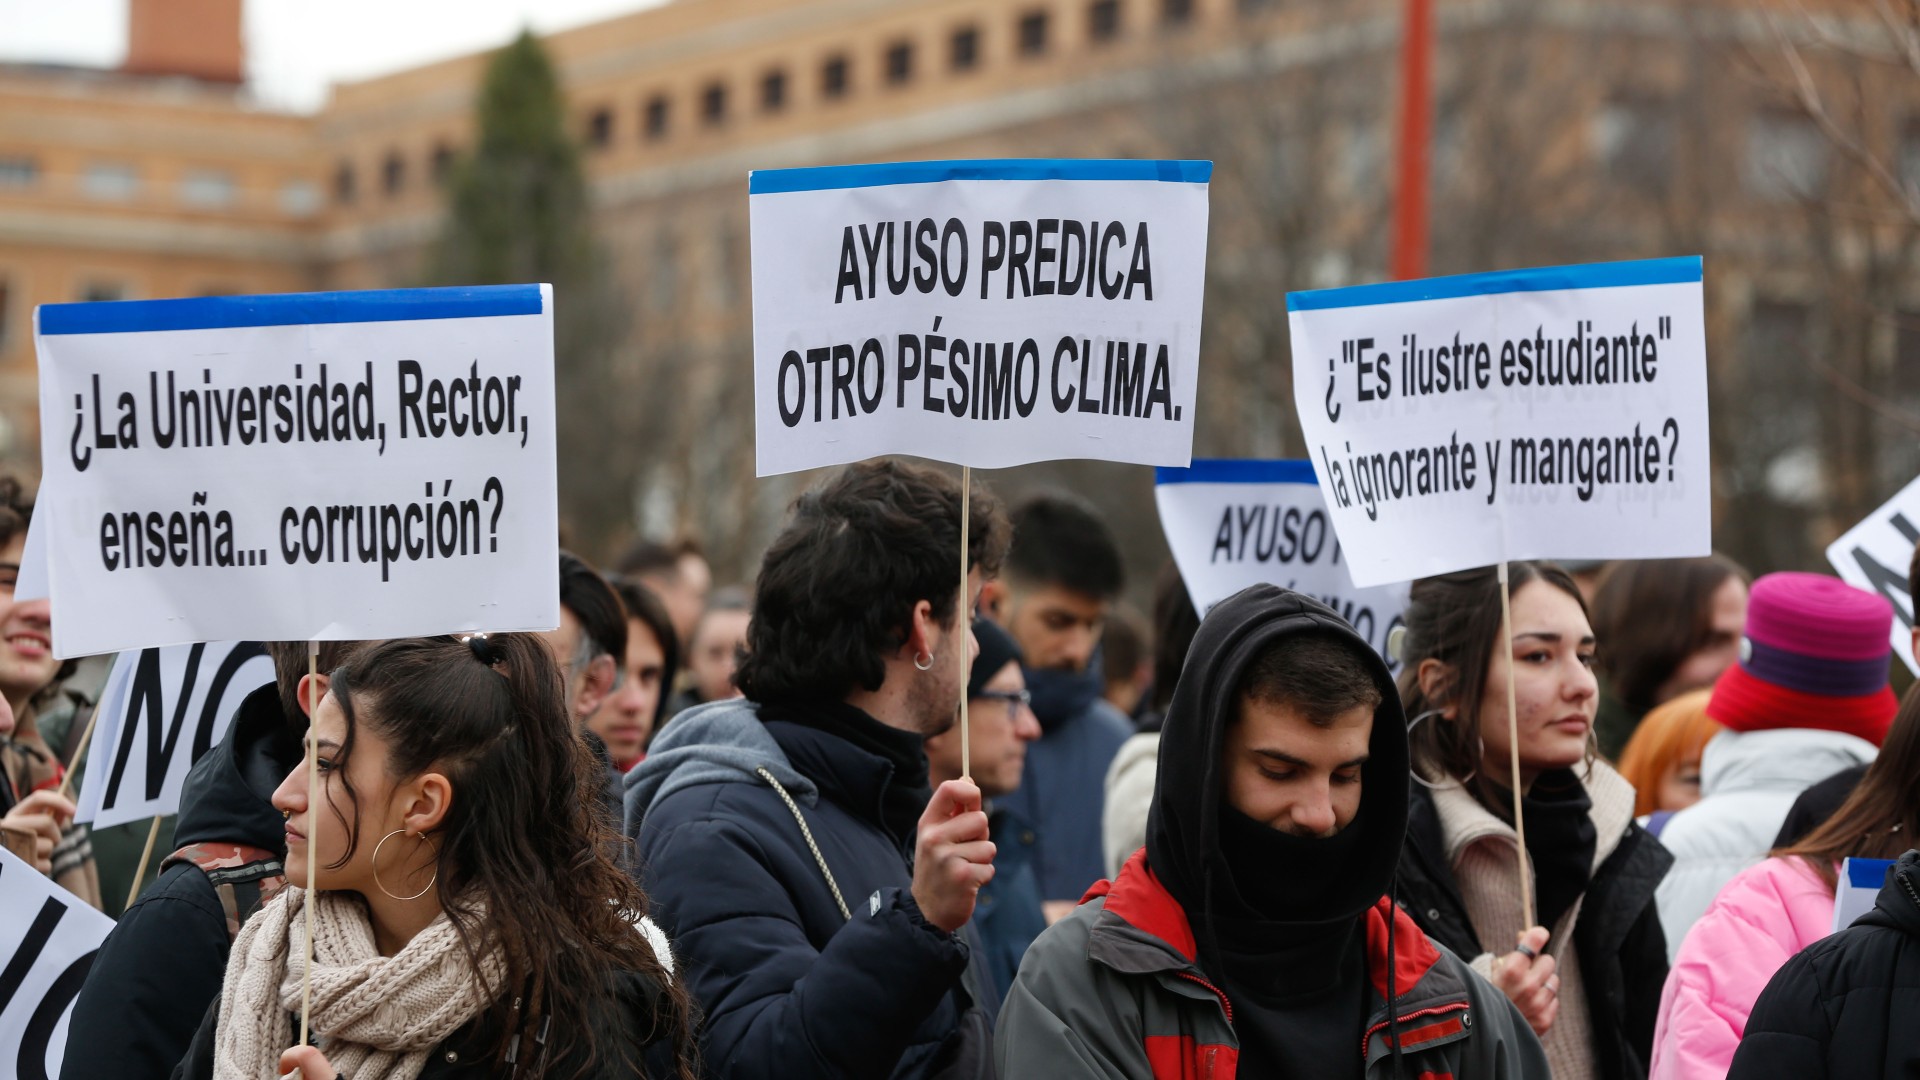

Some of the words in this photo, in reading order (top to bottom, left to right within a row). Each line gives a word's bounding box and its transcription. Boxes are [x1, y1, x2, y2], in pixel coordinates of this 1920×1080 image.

[834, 217, 969, 305] AYUSO
[980, 218, 1154, 302] PREDICA
[777, 337, 885, 428] OTRO
[896, 315, 1040, 421] PÉSIMO
[1050, 335, 1182, 421] CLIMA.
[1402, 332, 1491, 397] ilustre
[1499, 316, 1672, 387] estudiante"
[70, 373, 139, 473] ¿La
[149, 360, 387, 457] Universidad,
[397, 358, 529, 449] Rector,
[1321, 446, 1352, 509] la
[1344, 431, 1477, 522] ignorante
[1485, 439, 1501, 505] y
[1510, 417, 1680, 503] mangante?
[100, 491, 268, 572] enseña...
[279, 476, 505, 583] corrupción?
[1211, 503, 1328, 566] AYUSO
